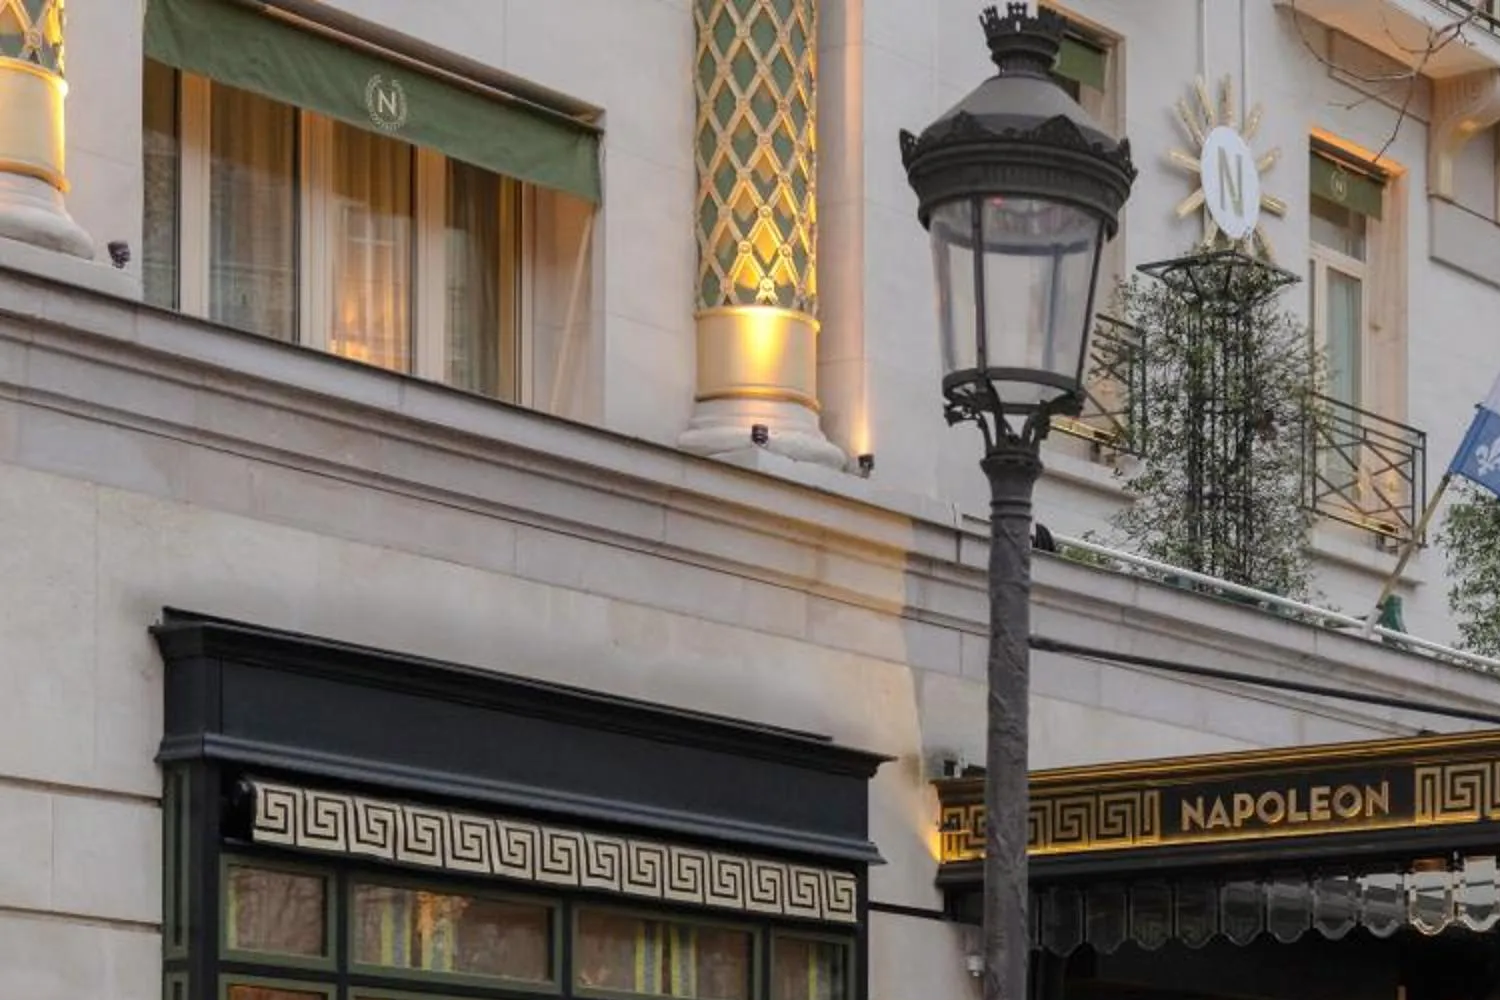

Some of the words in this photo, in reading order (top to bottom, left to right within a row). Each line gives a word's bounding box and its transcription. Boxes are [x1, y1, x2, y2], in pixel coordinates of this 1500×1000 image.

[378, 88, 398, 117] N
[1217, 145, 1244, 218] N
[1180, 780, 1390, 832] NAPOLEON
